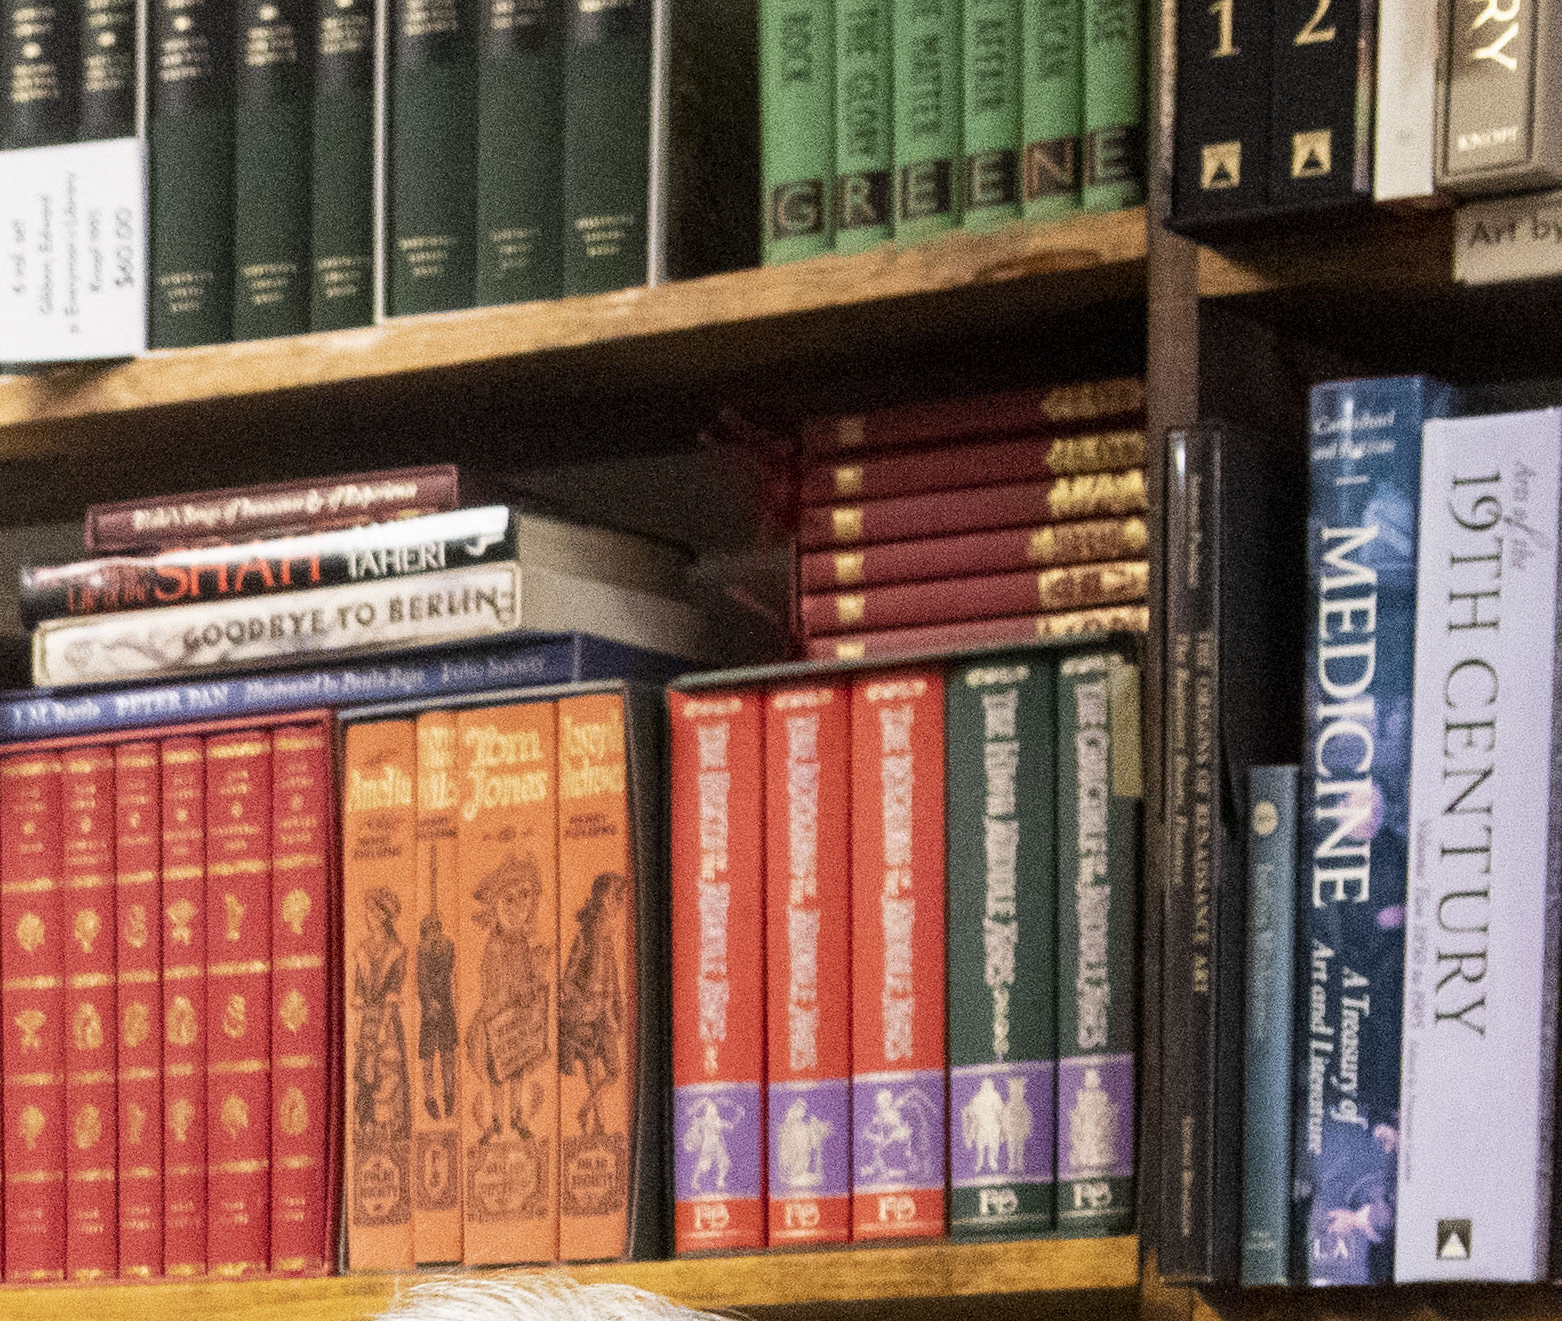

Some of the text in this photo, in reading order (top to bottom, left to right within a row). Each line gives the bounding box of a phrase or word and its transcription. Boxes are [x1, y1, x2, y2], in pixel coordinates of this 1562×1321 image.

[1208, 0, 1240, 58] 1
[1468, 220, 1515, 248] Art
[346, 542, 447, 579] TAHERI
[182, 587, 498, 649] GOODBYE TO BERLIN
[464, 725, 543, 766] Tom
[1313, 524, 1380, 909] MEDICINE
[1434, 470, 1506, 1040] 19TH CENTURY
[463, 768, 548, 821] Jones
[1308, 940, 1334, 1155] Art and Literature
[1329, 968, 1370, 1130] A Treasury of
